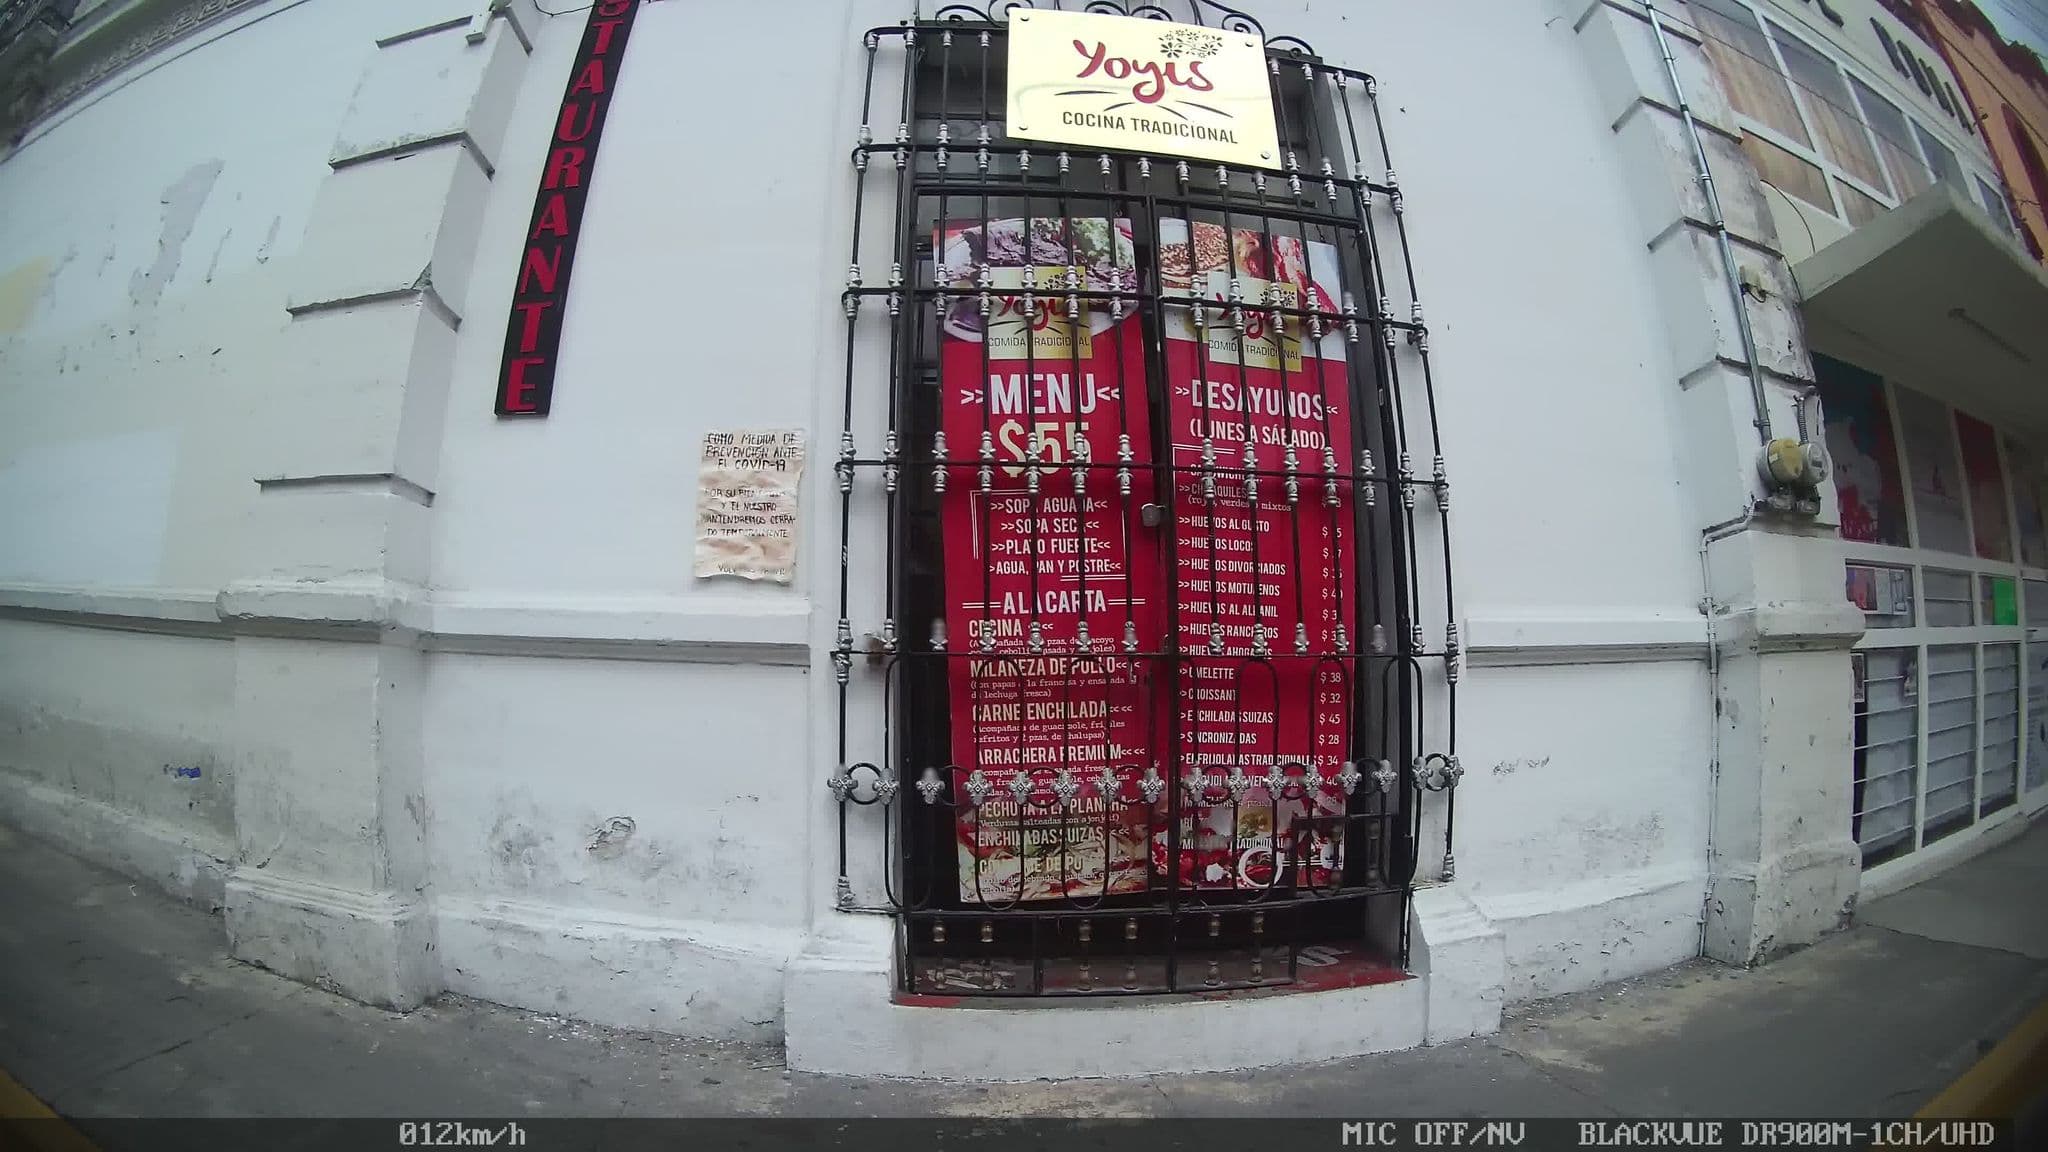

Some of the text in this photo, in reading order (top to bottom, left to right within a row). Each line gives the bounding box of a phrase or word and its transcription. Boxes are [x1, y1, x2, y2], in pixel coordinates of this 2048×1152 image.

[1072, 39, 1214, 104] Yogis
[1062, 111, 1239, 144] COCINA TRADICIONAL
[1033, 336, 1090, 348] RADICIOAL
[1208, 339, 1300, 361] COMID TRADICINAL
[990, 373, 1097, 415] MENU
[1191, 378, 1324, 421] DESAYUNOS
[1191, 482, 1248, 498] CHQUILES
[1005, 498, 1039, 514] SOP
[704, 513, 766, 525] ANTENDREMOS
[1053, 518, 1087, 533] SEC
[1191, 515, 1270, 532] HUEOS AL GUTO
[1006, 539, 1045, 555] PLAO
[1191, 536, 1228, 550] HUEOS
[1036, 559, 1054, 573] AN
[1058, 559, 1065, 573] Y
[1191, 558, 1286, 576] HUEOS DIVORIADOS
[1003, 591, 1016, 615] A
[1045, 589, 1107, 613] CARTA
[1228, 603, 1240, 616] AL
[1189, 622, 1279, 639] HUES RANCROS
[1049, 657, 1067, 675] DE
[1039, 678, 1077, 688] francsa
[1087, 676, 1125, 686] ensaada
[972, 700, 1107, 722] CARNE ENCHILADA
[1187, 709, 1274, 724] ECHILADA SUIZAS
[1067, 731, 1105, 741] halupas)
[1186, 731, 1257, 745] SNCRONIZDAS
[1185, 752, 1249, 766] EFRIJOLAAS
[979, 800, 1036, 818] PECHUA
[1070, 796, 1128, 814] PLANHA
